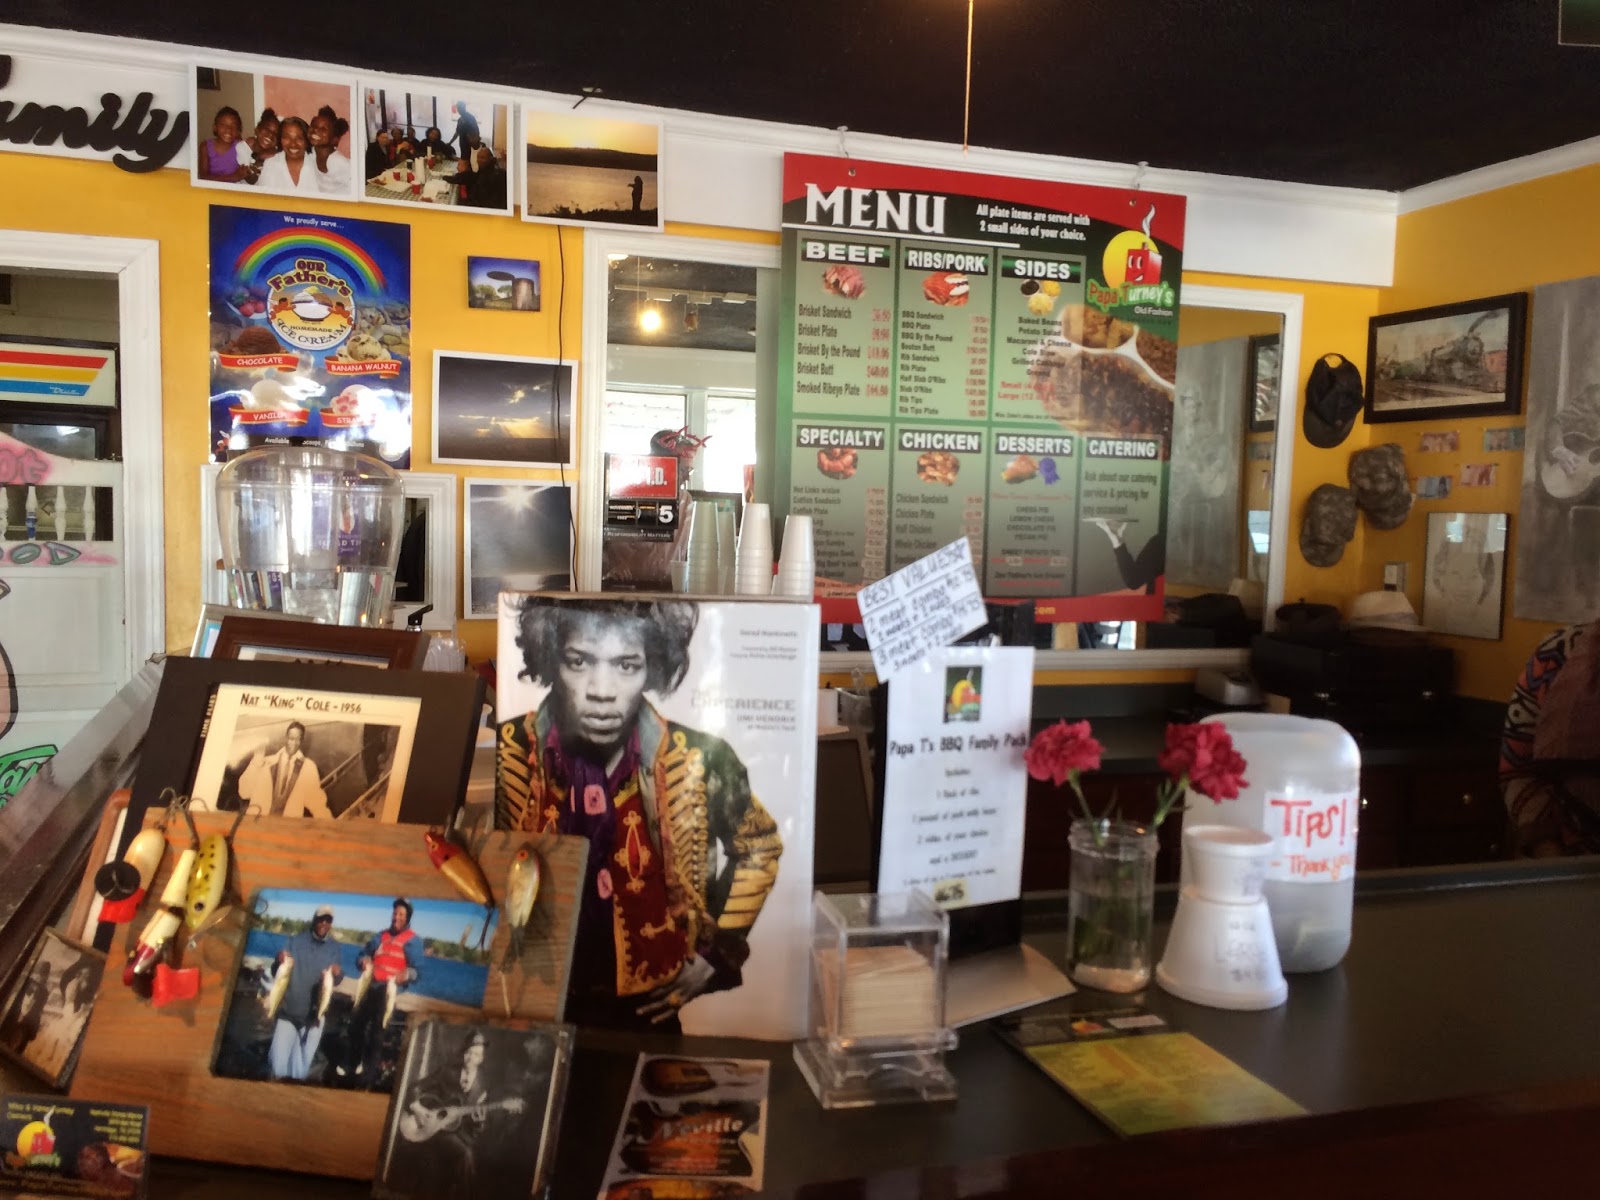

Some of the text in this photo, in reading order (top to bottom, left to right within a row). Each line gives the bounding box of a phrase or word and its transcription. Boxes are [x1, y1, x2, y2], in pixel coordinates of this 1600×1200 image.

[804, 183, 947, 234] MENU
[976, 204, 1091, 226] All plate items are served with
[283, 215, 295, 224] We
[295, 217, 319, 228] proudly
[979, 220, 1087, 241] 2 small sides of your choice.
[805, 241, 885, 264] BEEF
[296, 259, 325, 272] OUR
[907, 250, 986, 273] RIBS/PORK
[1014, 259, 1071, 280] SIDES
[269, 271, 352, 297] Father's
[1089, 281, 1175, 307] Papa Turney's
[798, 304, 852, 320] Brisket Sandwich
[901, 310, 945, 321] BBQ Sandwich
[1134, 306, 1147, 315] Old
[290, 325, 333, 333] HOMEMADE
[901, 321, 931, 330] BBQ Plate
[1018, 316, 1041, 326] Baked
[276, 318, 347, 345] ICE CREAM
[798, 323, 838, 338] Brisket Plate
[901, 331, 953, 343] BBQ By the Pound
[797, 342, 861, 359] Brisket By the Pound
[900, 342, 921, 351] Boston
[236, 357, 284, 366] CHOCOLATE
[900, 353, 940, 363] Rib Sandwich
[331, 363, 397, 372] BANANA WALNUT
[797, 362, 834, 375] Brisket Butt
[911, 364, 926, 373] Plate
[796, 381, 860, 398] Smoked Ribeye Plate
[264, 437, 290, 445] Available
[799, 427, 883, 447] SPECIALTY
[901, 431, 979, 451] CHICKEN
[998, 436, 1072, 454] DESSERTS
[1088, 440, 1156, 458] CATERING
[658, 504, 674, 524] 5
[340, 701, 362, 714] 1956
[890, 741, 914, 758] Papa
[919, 737, 934, 752] T's
[939, 736, 963, 751] BBQ
[968, 734, 999, 752] Family
[1269, 798, 1348, 848] Tips!
